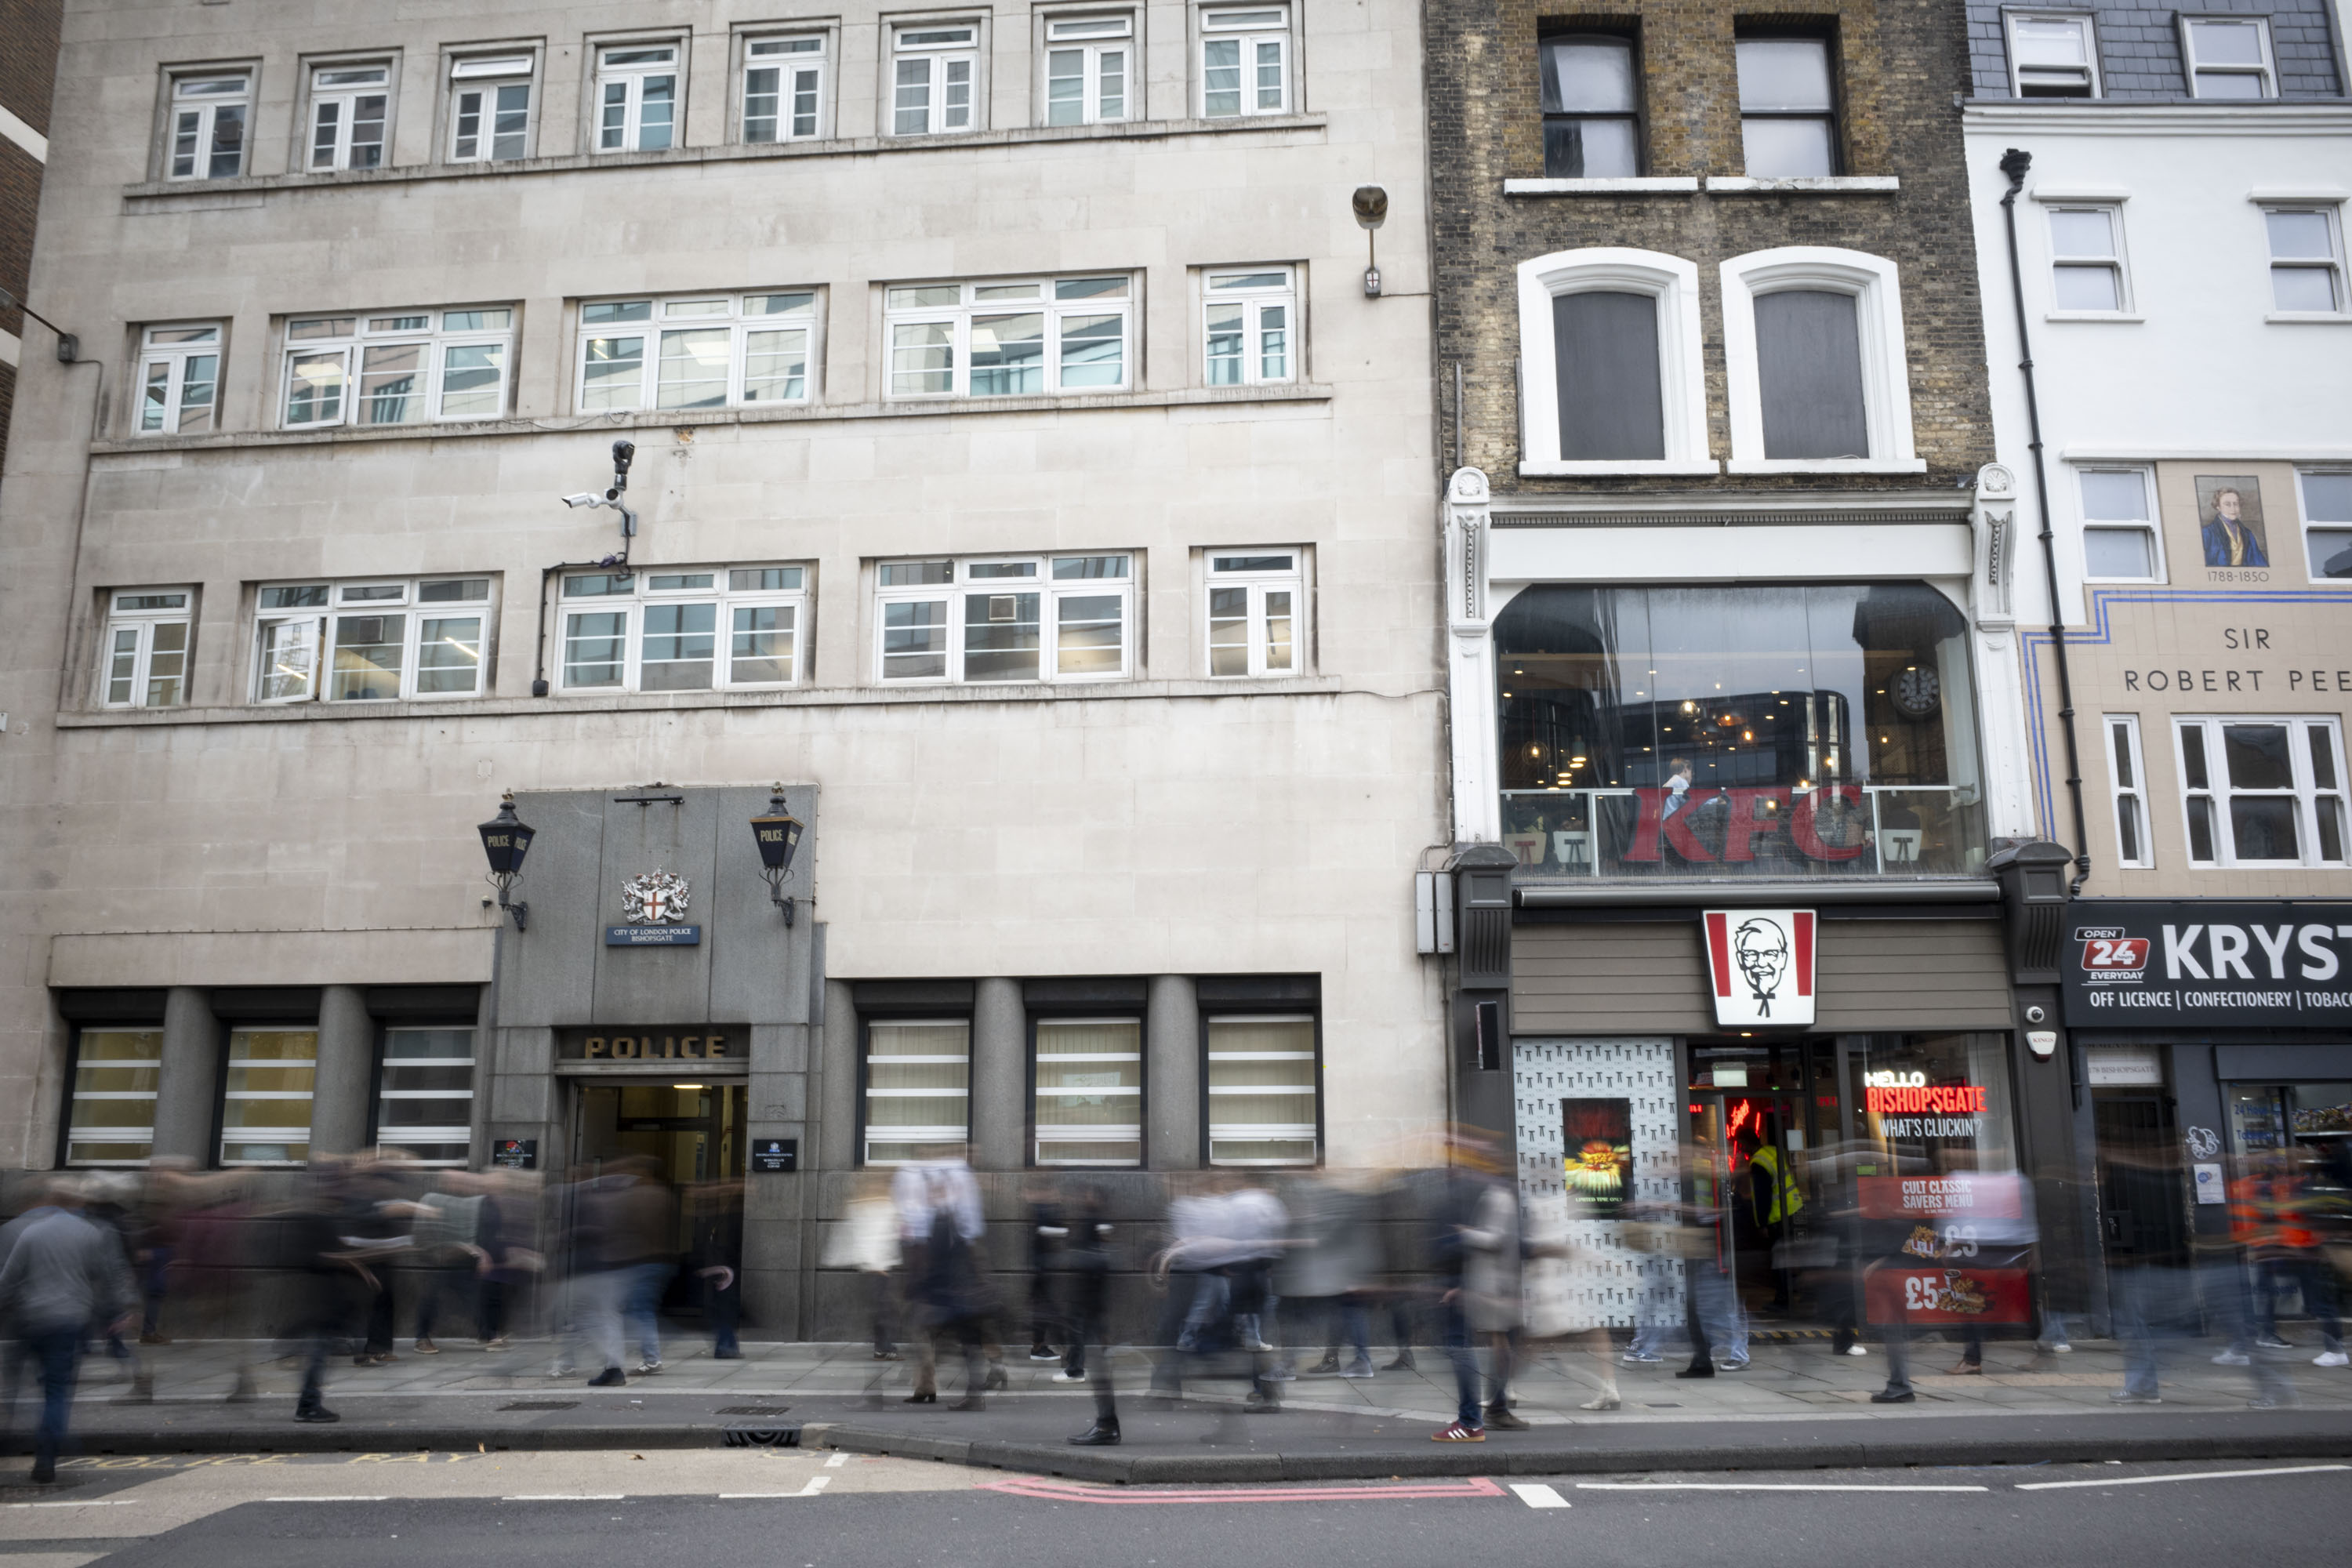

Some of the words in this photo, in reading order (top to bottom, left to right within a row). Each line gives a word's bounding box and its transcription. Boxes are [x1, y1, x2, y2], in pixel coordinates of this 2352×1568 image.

[2208, 571, 2270, 583] 1788-1850
[2223, 628, 2271, 649] SIR
[2125, 670, 2264, 691] ROBERT
[2288, 670, 2352, 691] PEE
[1624, 785, 1864, 862] KFC
[488, 835, 509, 847] POLICE
[760, 829, 782, 842] POLICE
[2084, 930, 2117, 938] OPEN
[2092, 941, 2136, 965] 24
[2089, 992, 2114, 1007] OFF
[2118, 992, 2172, 1007] LICENCE
[2184, 992, 2292, 1007] CONFECTIONERY
[585, 1036, 724, 1058] POLICE
[1864, 1071, 1926, 1087] HELLO
[1865, 1087, 1987, 1112] BISHOPSGATE
[1878, 1118, 1922, 1137] WHAT'S
[1924, 1118, 1983, 1137] CLUCKIN'?
[1902, 1181, 1927, 1194] CULT
[1929, 1180, 1972, 1194] CLASSIC
[1903, 1195, 1942, 1208] SAVERS
[1945, 1194, 1973, 1207] MENU
[1905, 1276, 1938, 1310] £5
[55, 1454, 292, 1468] POLICE
[347, 1452, 487, 1465] BAY
